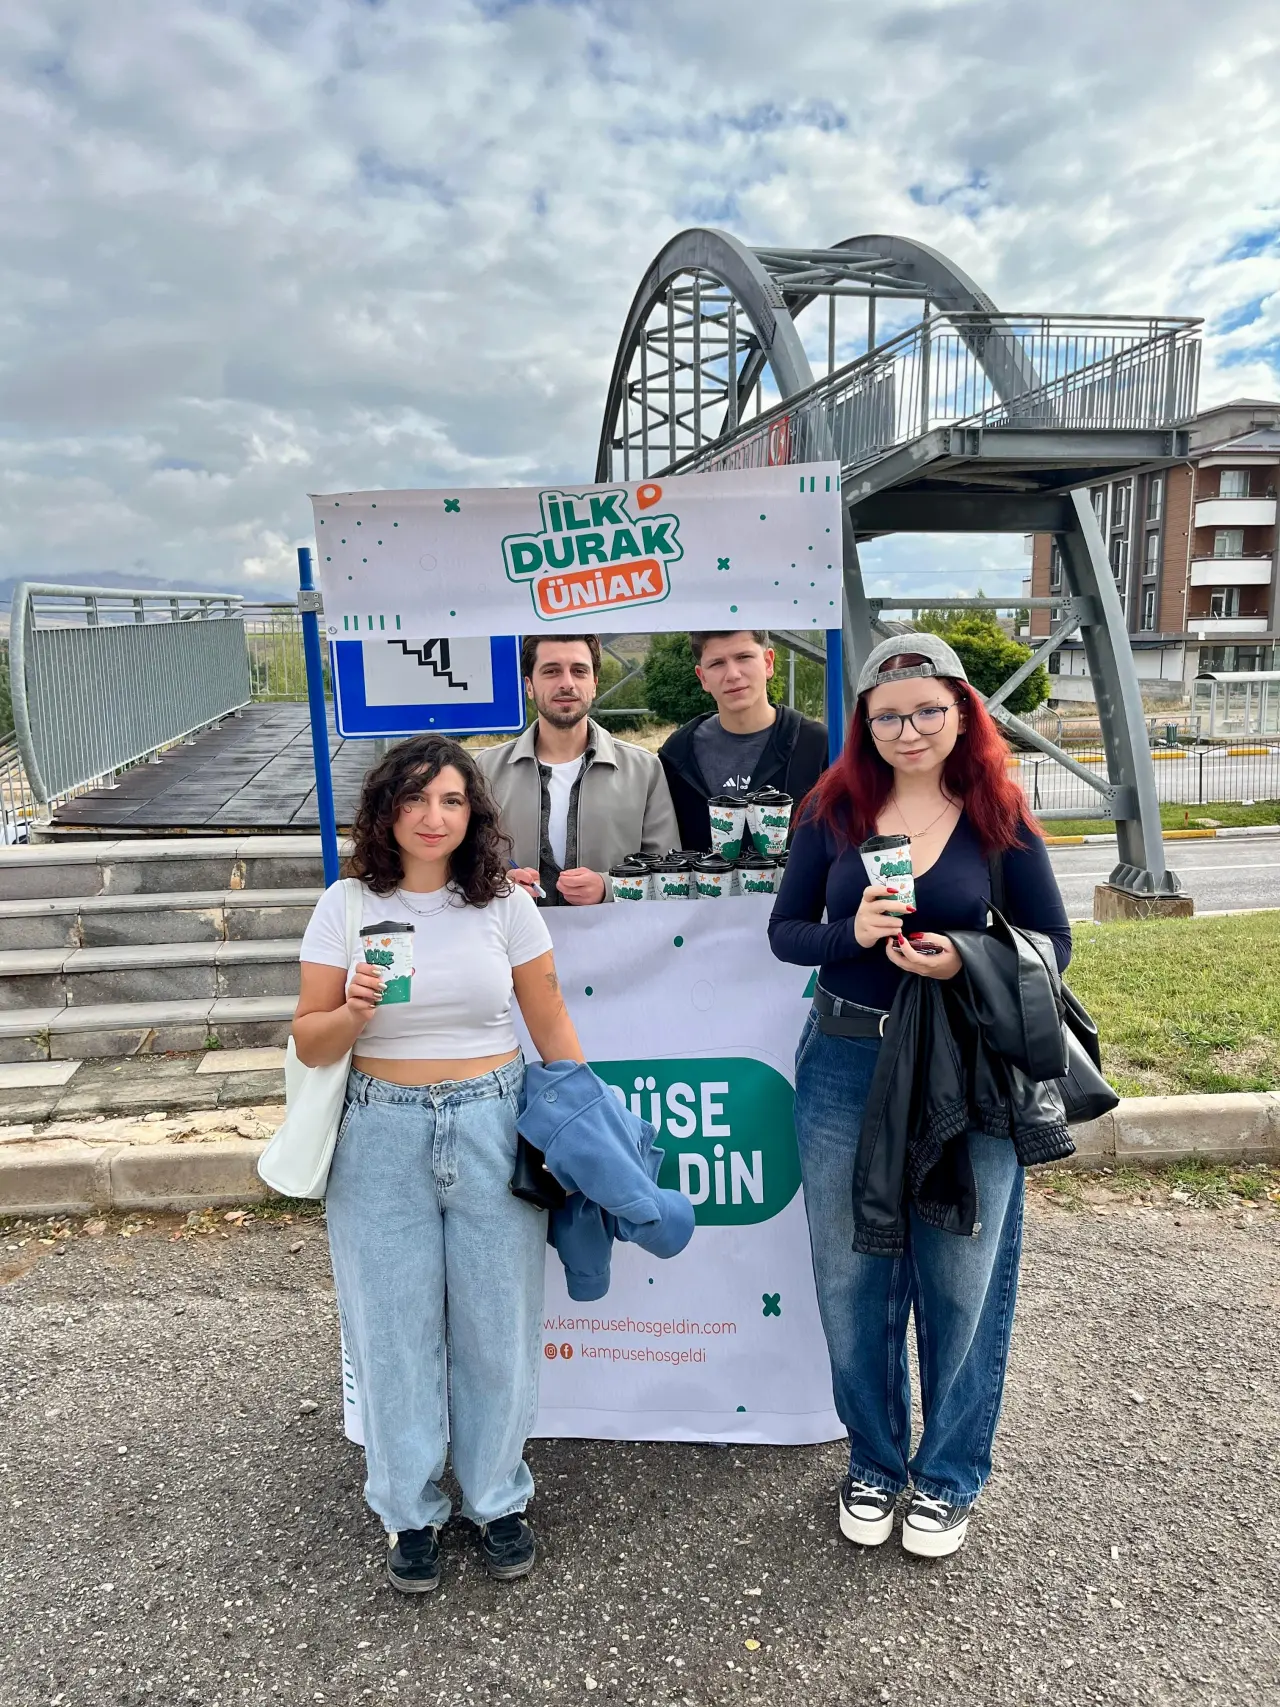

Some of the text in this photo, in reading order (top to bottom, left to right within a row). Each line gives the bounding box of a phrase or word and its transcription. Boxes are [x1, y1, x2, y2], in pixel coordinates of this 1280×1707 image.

[548, 494, 623, 533] İLK
[510, 522, 675, 575] DURAK
[546, 568, 657, 610] ÜNİAK
[608, 1076, 731, 1138] ÜSE
[581, 1343, 706, 1365] kampusehosgeldi
